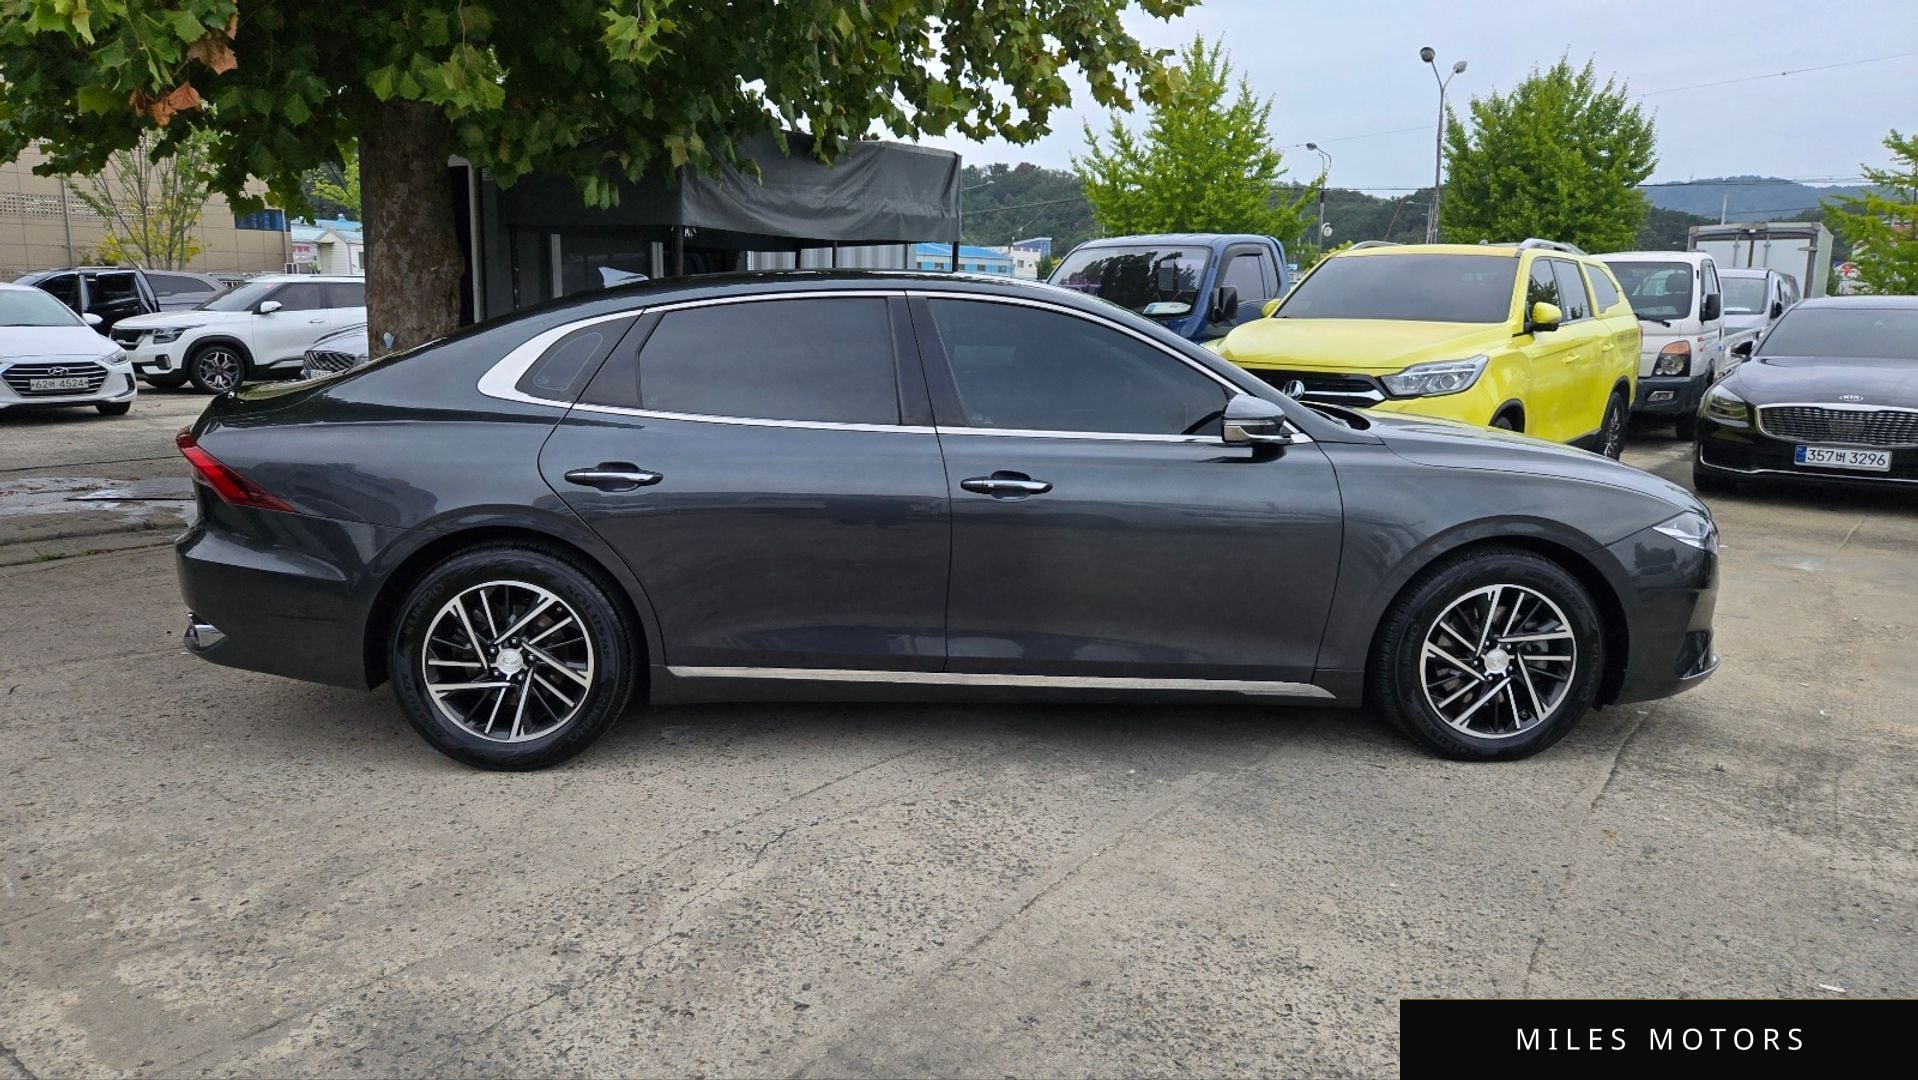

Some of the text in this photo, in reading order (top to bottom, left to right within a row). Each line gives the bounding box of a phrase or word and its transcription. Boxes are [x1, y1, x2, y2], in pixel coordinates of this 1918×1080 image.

[59, 378, 84, 388] 4524
[1807, 449, 1886, 466] 357버 3296
